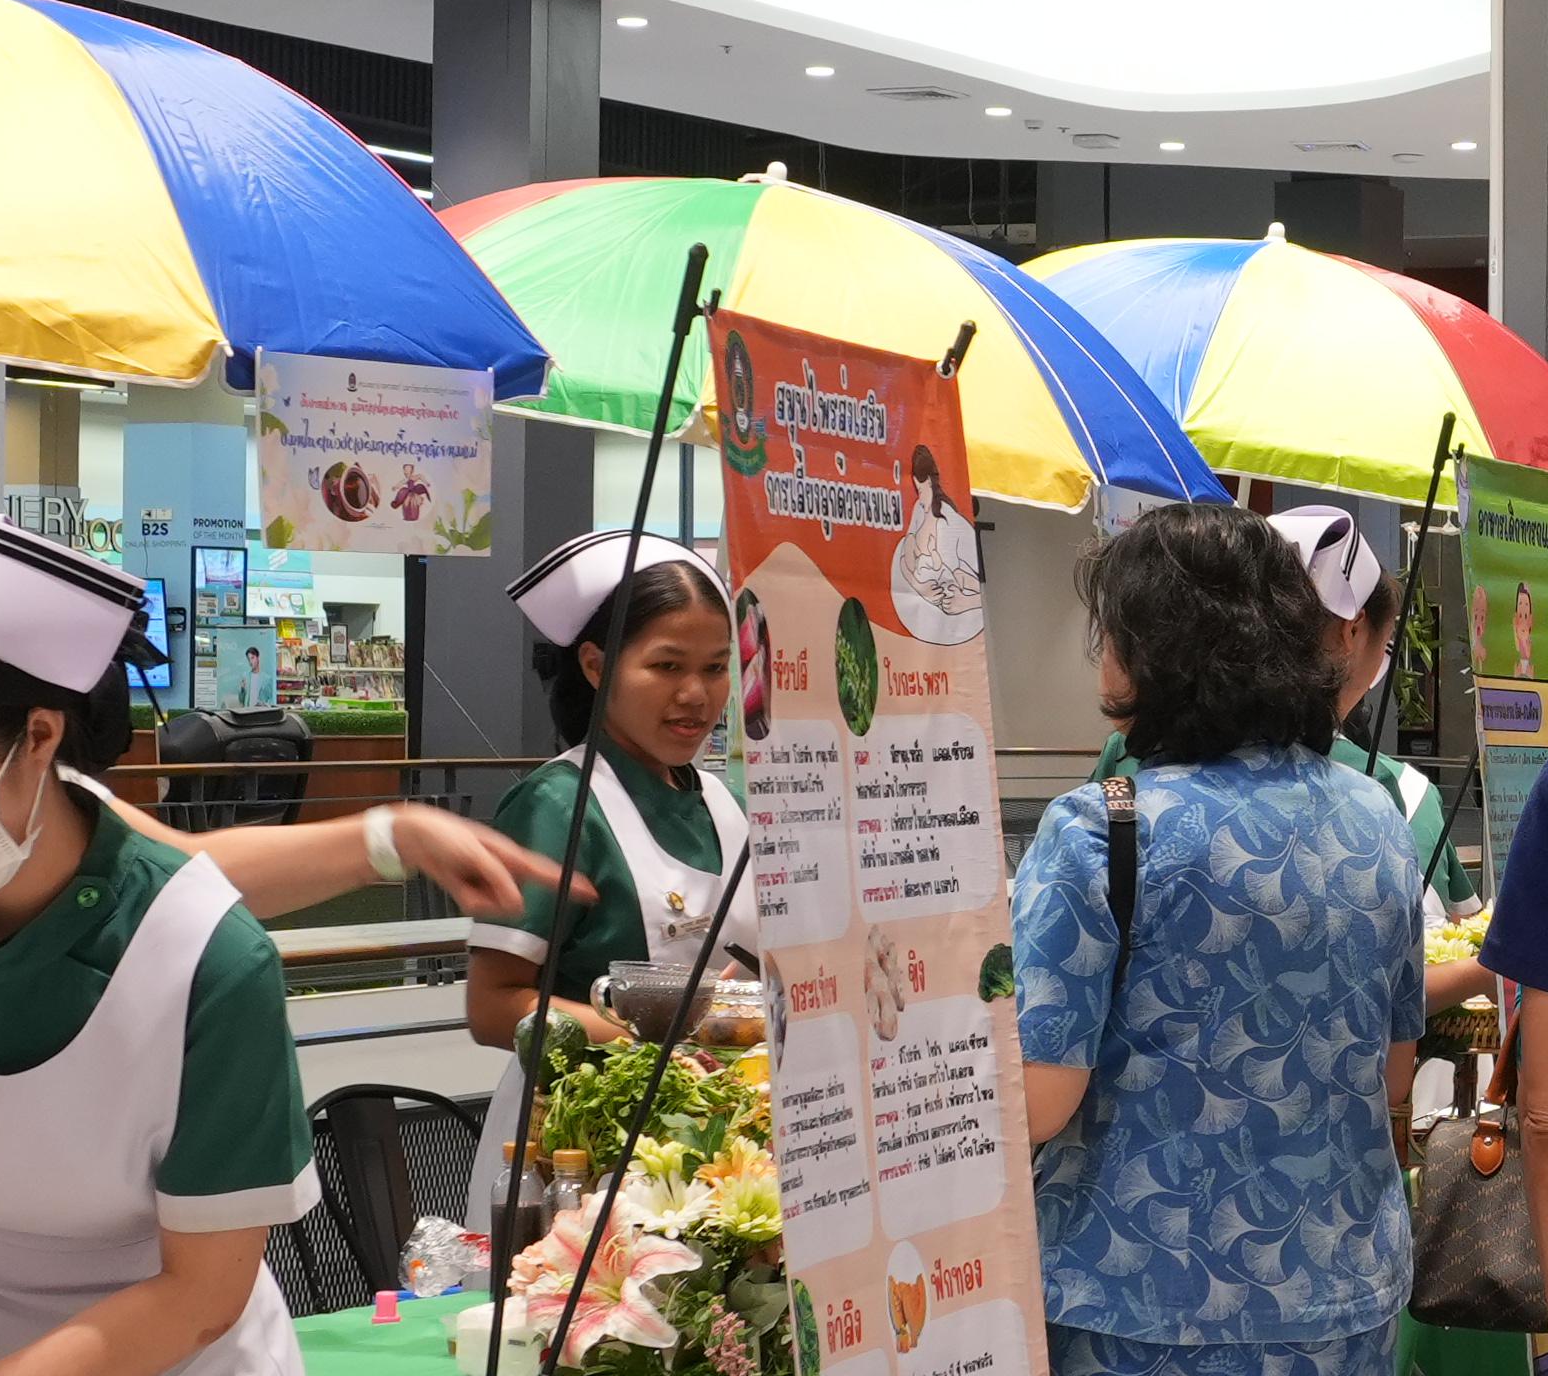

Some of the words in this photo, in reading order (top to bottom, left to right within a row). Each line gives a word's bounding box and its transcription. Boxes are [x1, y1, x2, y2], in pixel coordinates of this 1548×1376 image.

[142, 523, 169, 536] B2S
[193, 518, 244, 529] PROMOTION
[908, 950, 925, 994] ขิง
[930, 1258, 983, 1302] ฟักทอง
